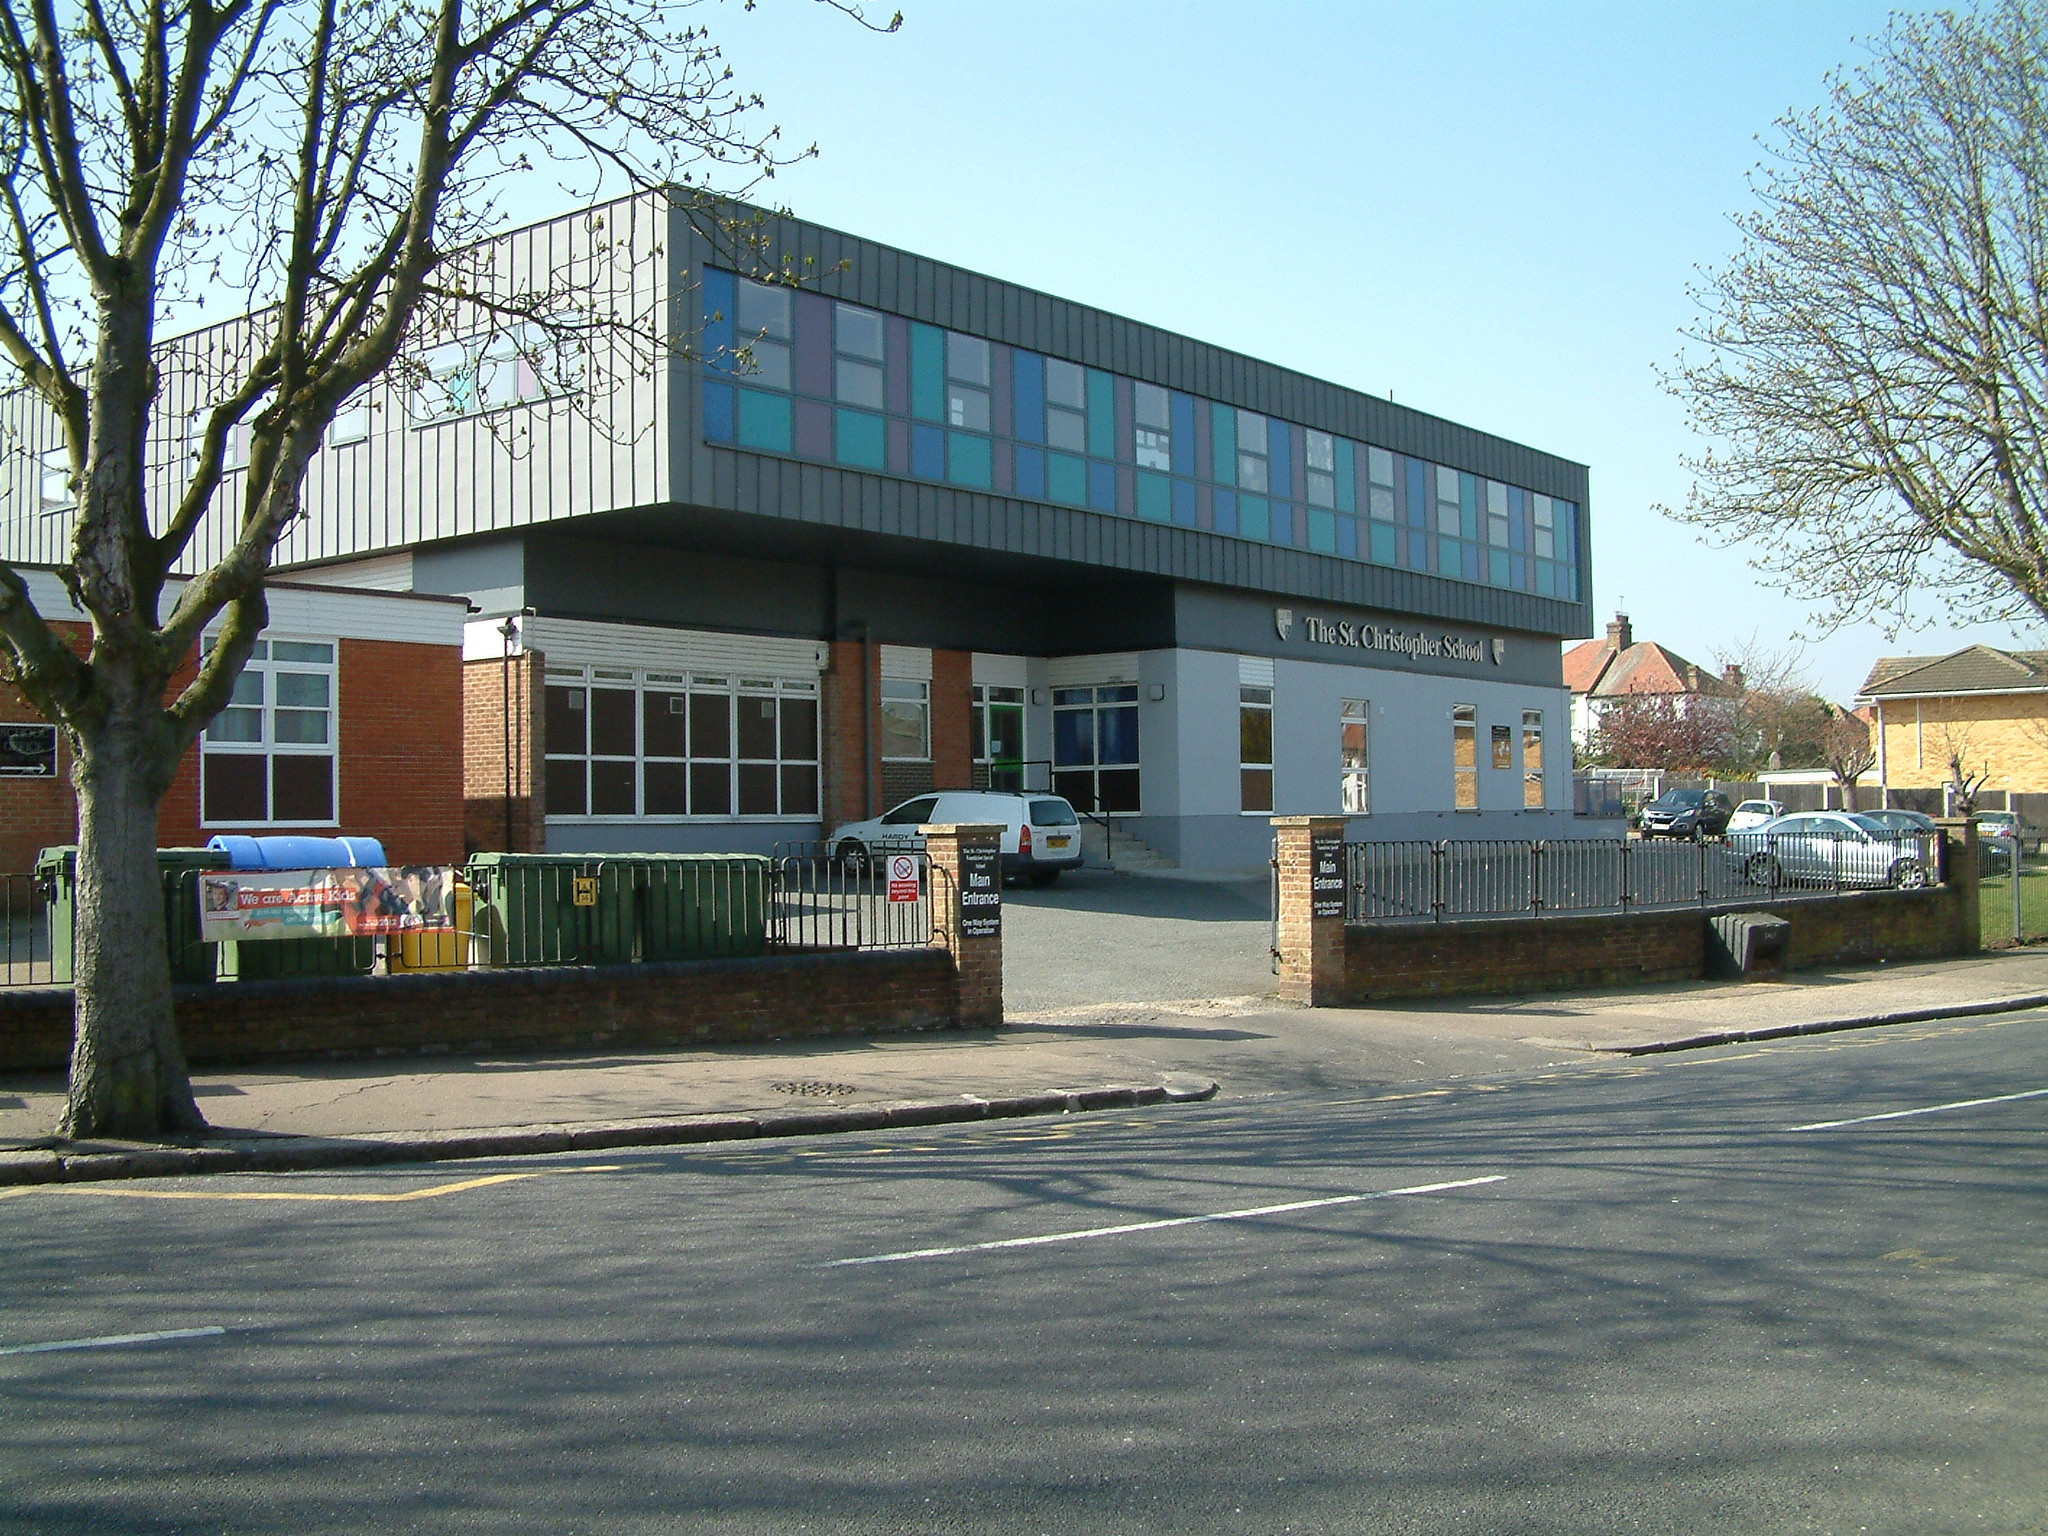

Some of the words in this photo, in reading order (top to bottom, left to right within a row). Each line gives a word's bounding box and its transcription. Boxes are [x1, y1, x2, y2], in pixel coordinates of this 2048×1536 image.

[1305, 616, 1337, 645] The
[1361, 624, 1442, 661] Christopher
[1443, 635, 1484, 663] School
[1319, 860, 1337, 874] Main
[970, 872, 990, 887] Main
[1313, 877, 1343, 890] Entrance
[240, 894, 259, 905] We
[262, 895, 284, 904] are
[286, 892, 325, 904] Active
[328, 888, 356, 901] Kids
[962, 891, 999, 905] Entrance
